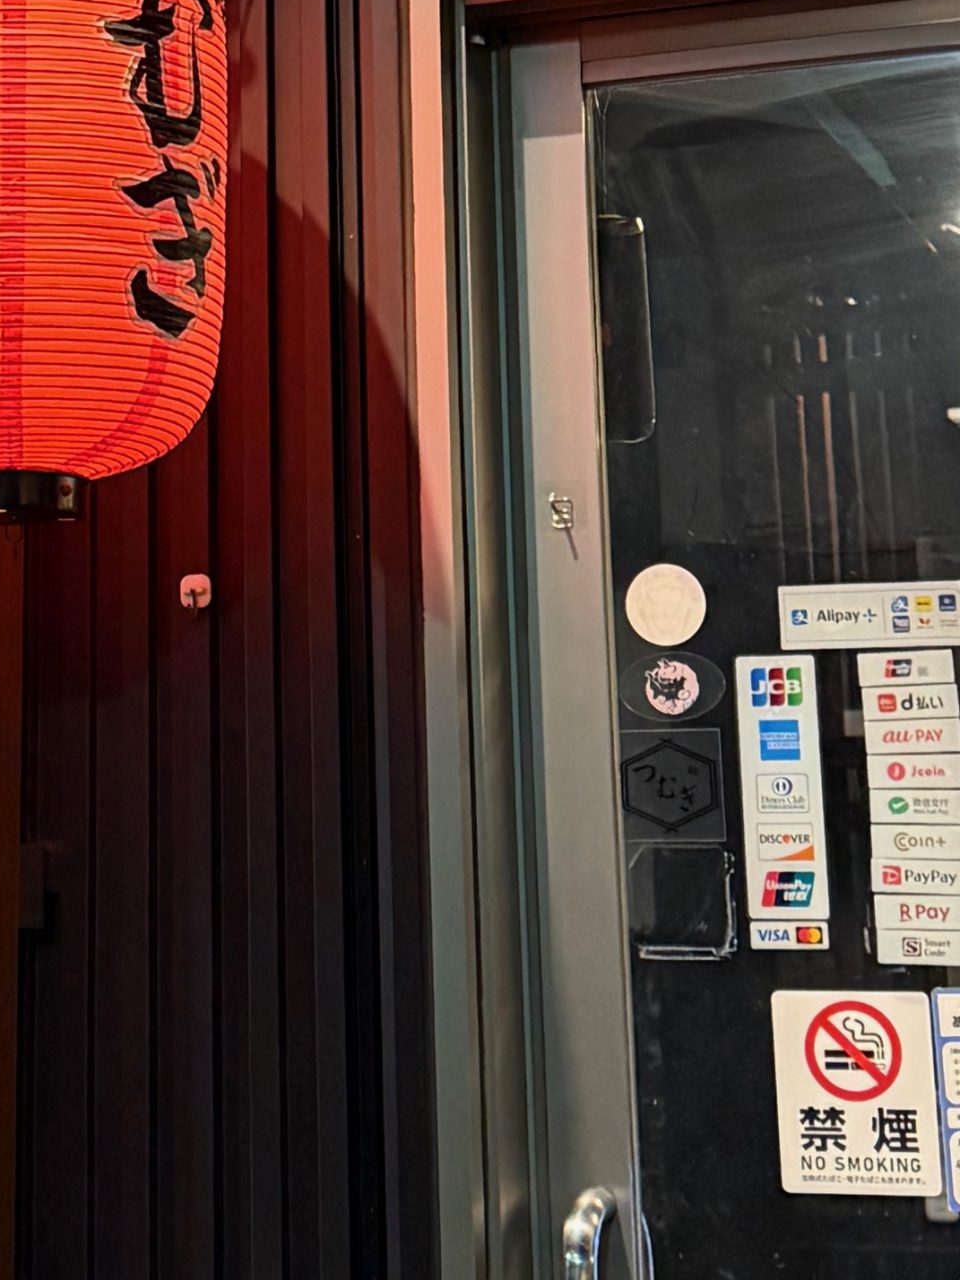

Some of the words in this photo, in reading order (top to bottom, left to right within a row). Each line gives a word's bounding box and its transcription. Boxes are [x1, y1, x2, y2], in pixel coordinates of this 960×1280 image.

[915, 729, 943, 742] PAY
[759, 834, 811, 844] DISCOVER
[904, 869, 958, 886] PayPay
[915, 904, 950, 922] Pay
[757, 928, 791, 942] VISA
[799, 1106, 920, 1153] 禁煙
[801, 1155, 826, 1171] NO
[834, 1156, 922, 1174] SMOKING
